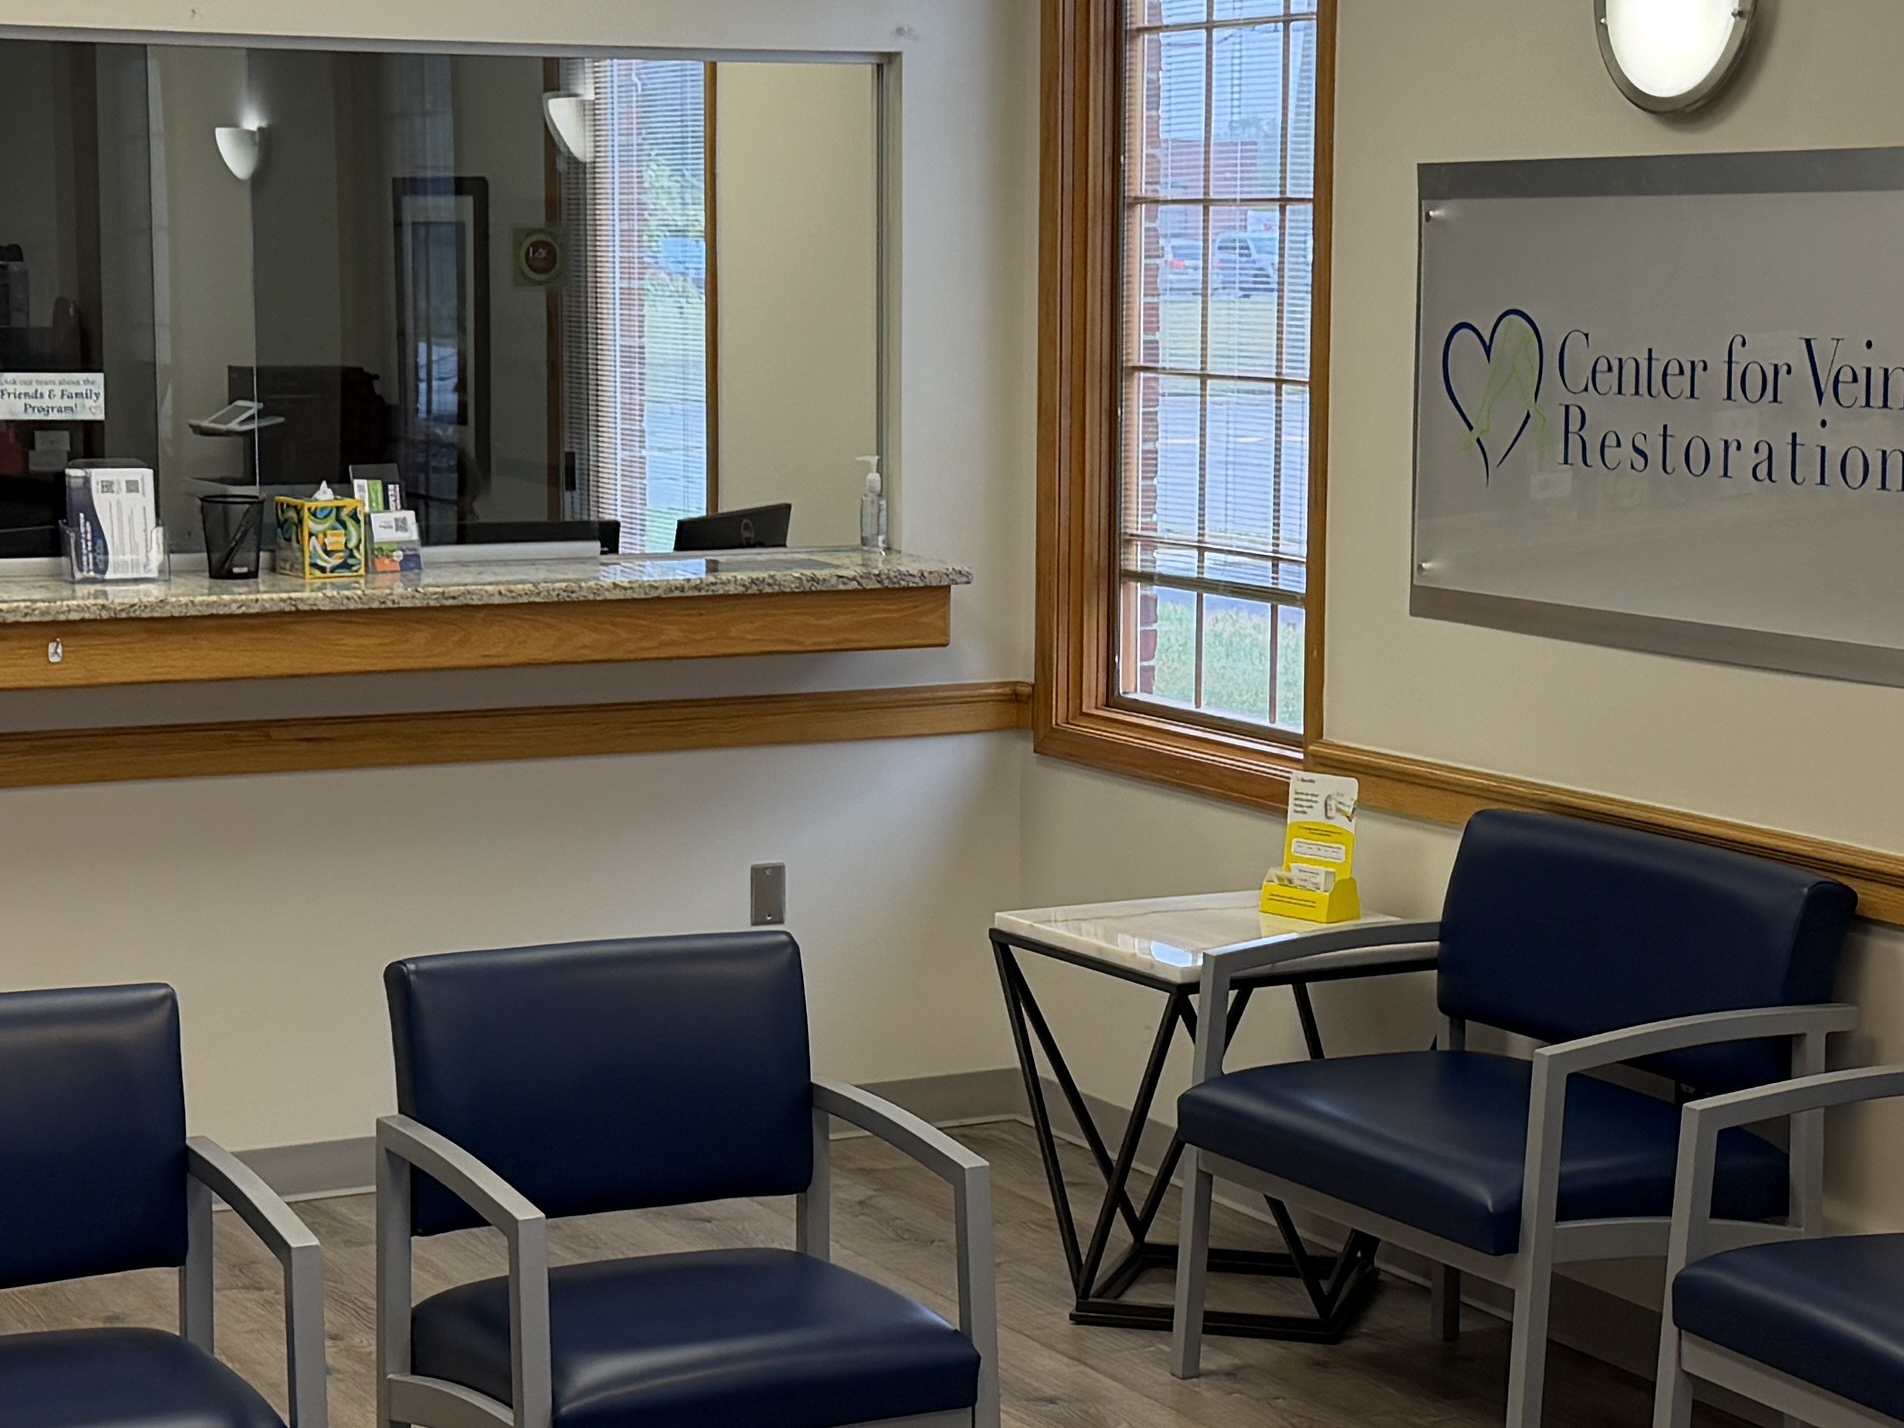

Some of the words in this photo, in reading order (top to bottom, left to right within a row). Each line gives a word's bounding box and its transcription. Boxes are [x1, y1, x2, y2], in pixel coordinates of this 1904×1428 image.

[1558, 329, 1708, 400] Center
[1722, 334, 1792, 404] for
[0, 389, 44, 400] Friends
[48, 390, 56, 400] &
[60, 388, 101, 403] Family
[23, 402, 78, 416] Program!
